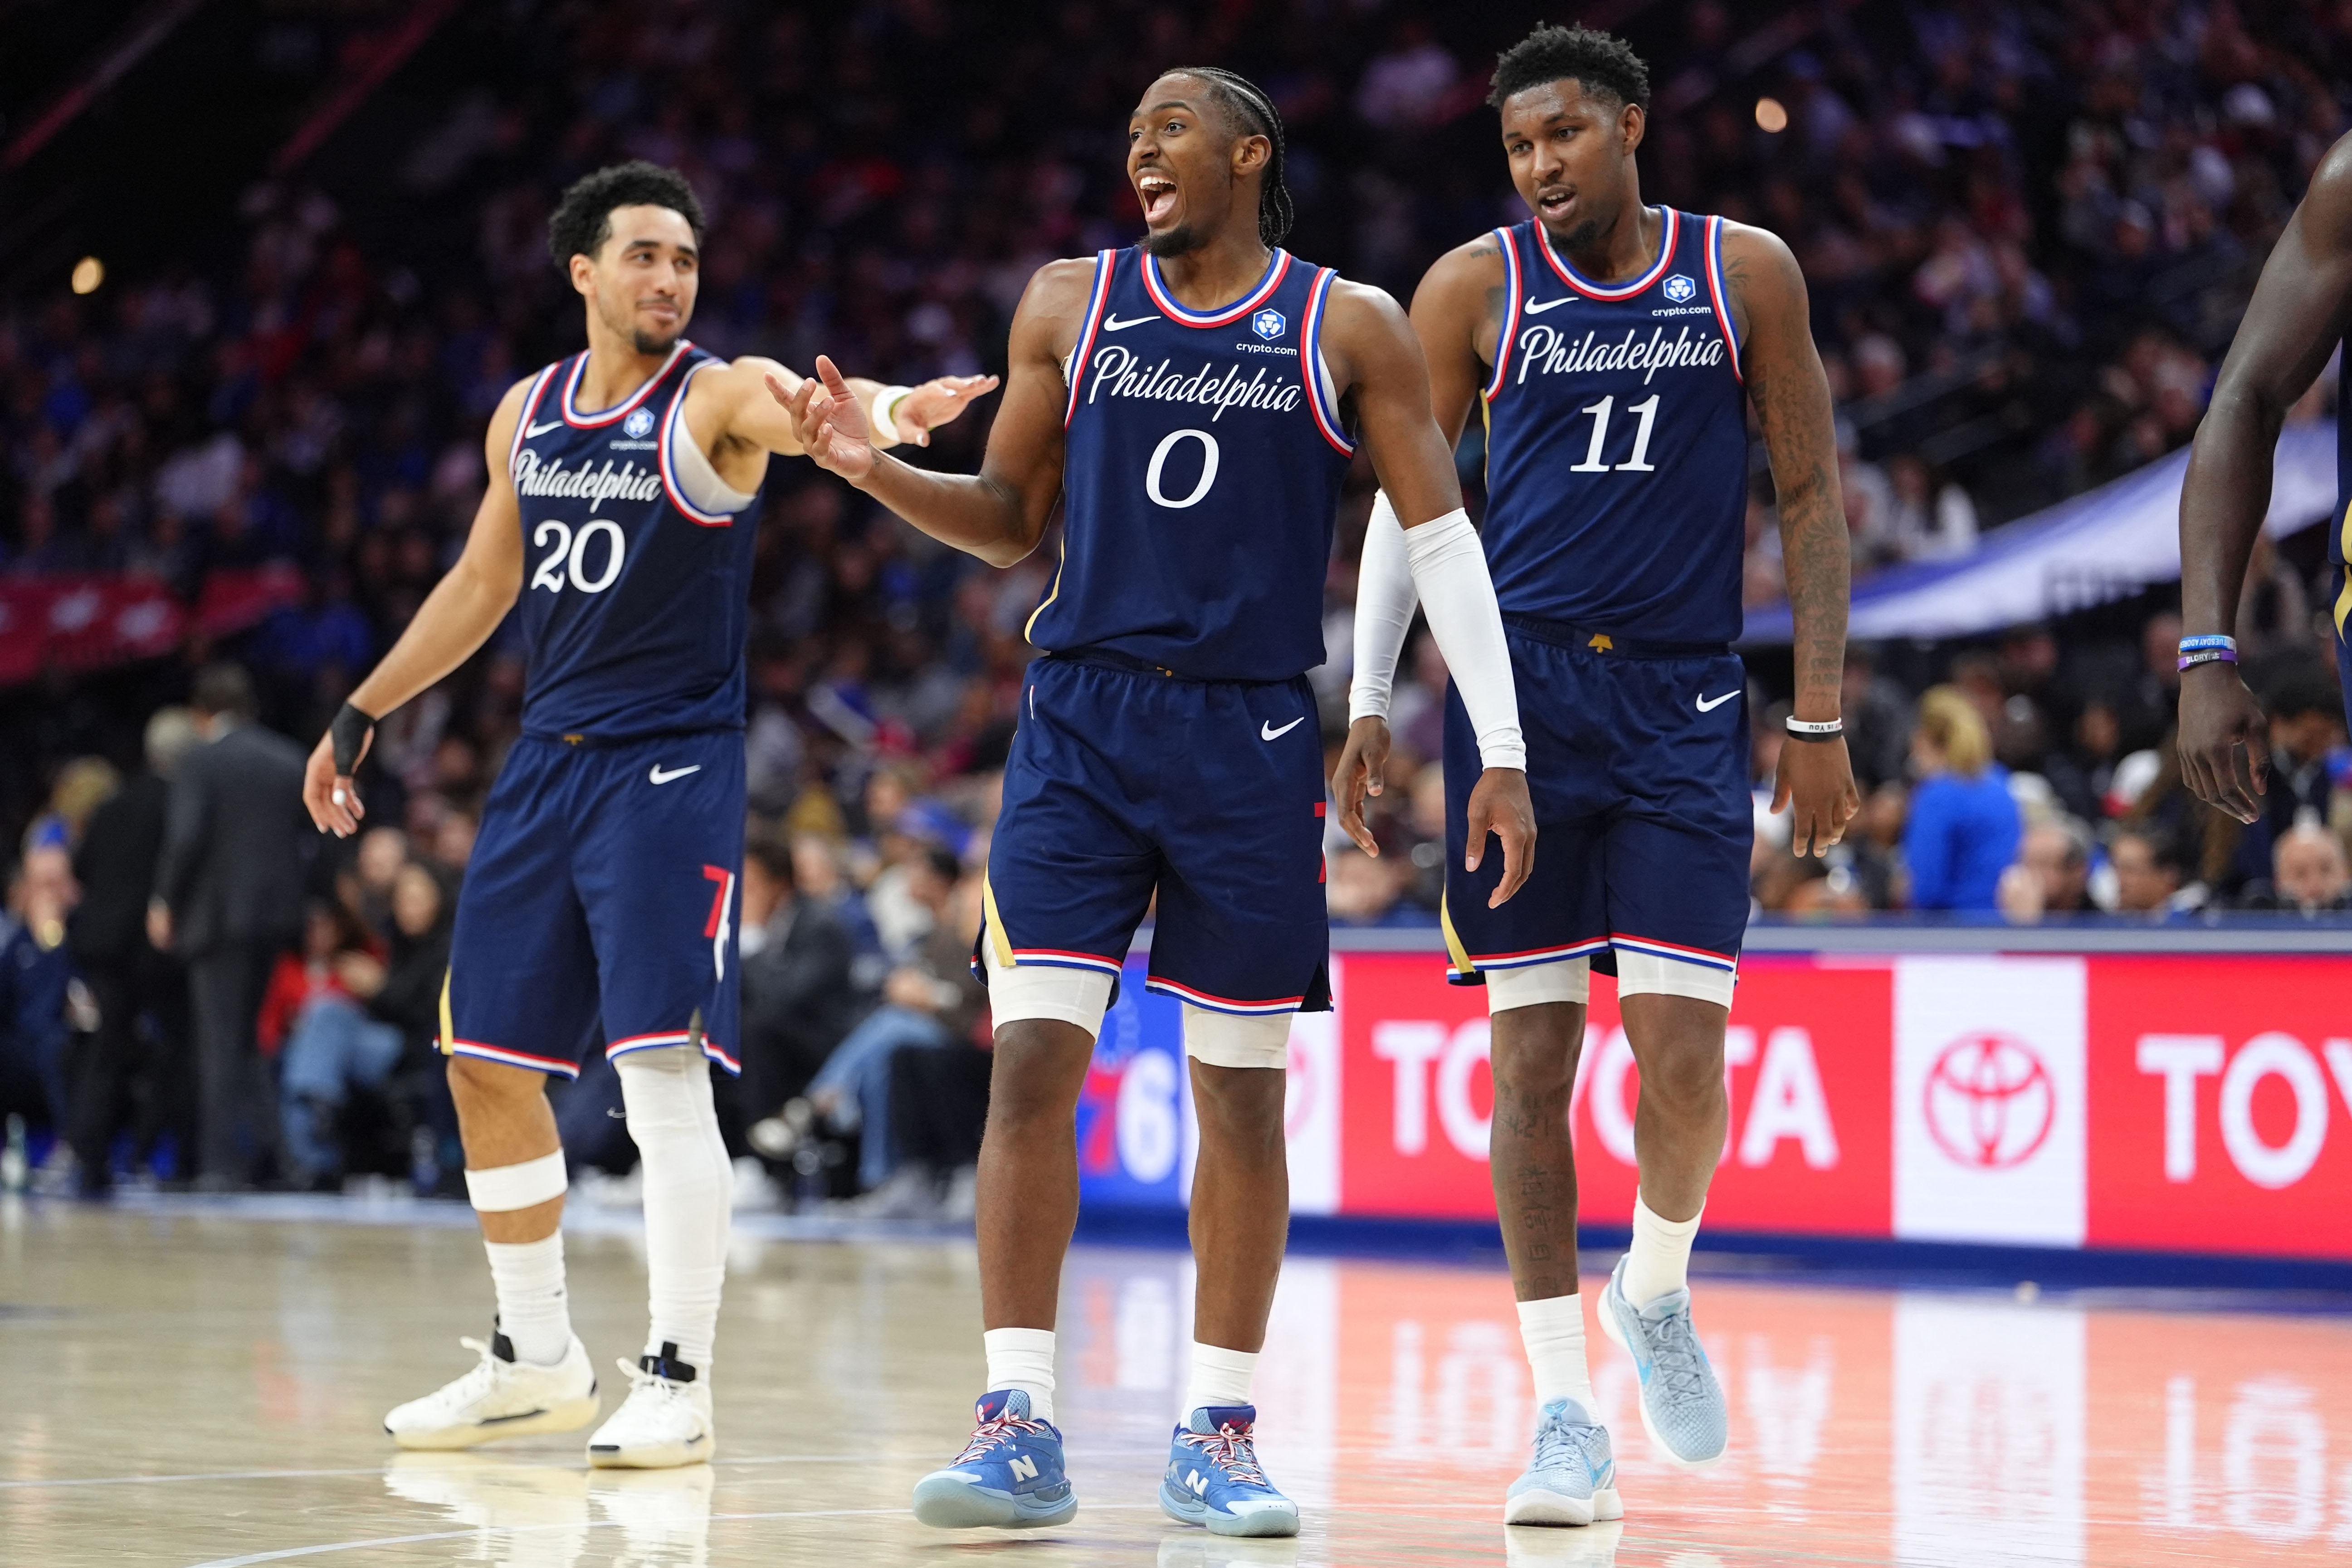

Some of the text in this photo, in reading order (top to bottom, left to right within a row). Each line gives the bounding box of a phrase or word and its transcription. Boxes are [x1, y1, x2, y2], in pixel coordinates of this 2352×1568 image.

[1651, 306, 1711, 317] crypto.com
[1235, 341, 1298, 356] crypto.com
[1517, 325, 1724, 385] Philadelphia
[1088, 346, 1303, 422] Philadelphia
[1570, 394, 1660, 472] 11
[513, 448, 662, 514] Philadelphia
[1146, 429, 1220, 508] 0
[531, 519, 626, 594] 20
[2186, 653, 2209, 663] GLORY
[1008, 1454, 1039, 1482] N
[1185, 1468, 1210, 1497] N
